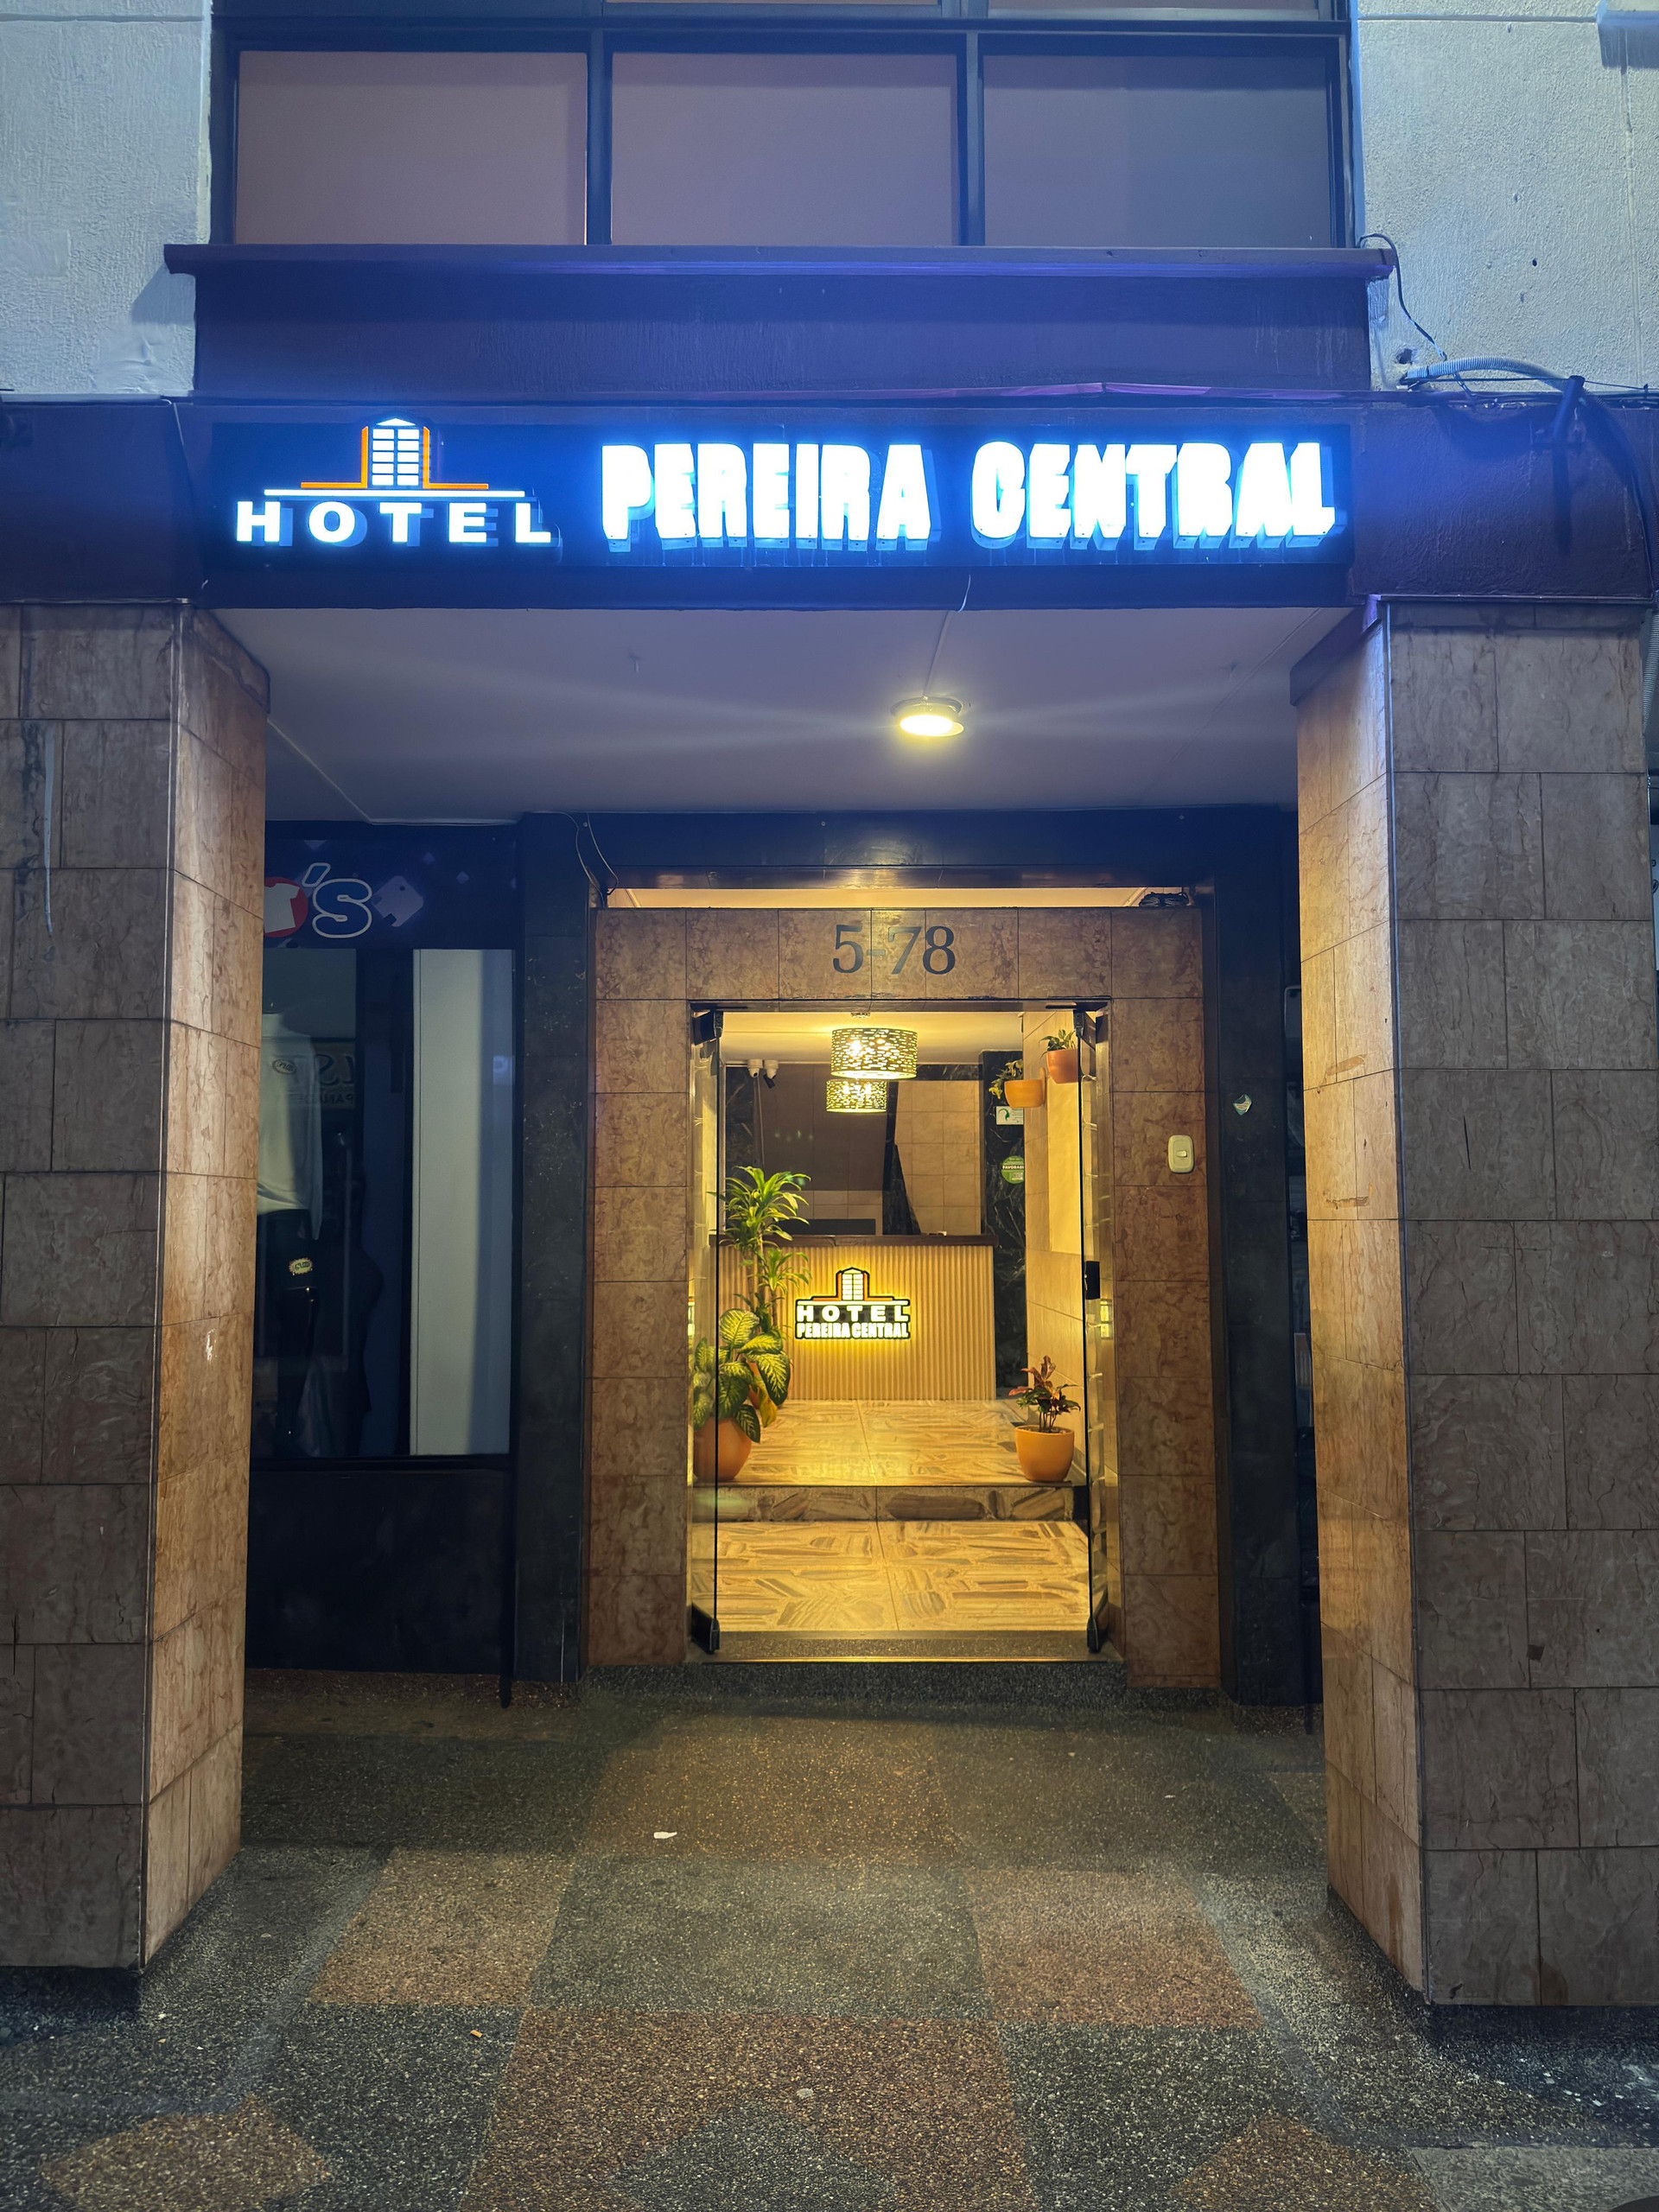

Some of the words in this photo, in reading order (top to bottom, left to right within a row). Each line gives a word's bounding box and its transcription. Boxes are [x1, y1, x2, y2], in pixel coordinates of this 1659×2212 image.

[236, 500, 553, 543] HOTEL
[601, 442, 931, 544] PEREIRA
[971, 441, 1337, 544] CENTRAL
[832, 924, 956, 976] 5-78
[796, 1305, 909, 1323] HOTEL
[796, 1322, 851, 1338] PEREIRA
[851, 1322, 909, 1338] CENTRAL
